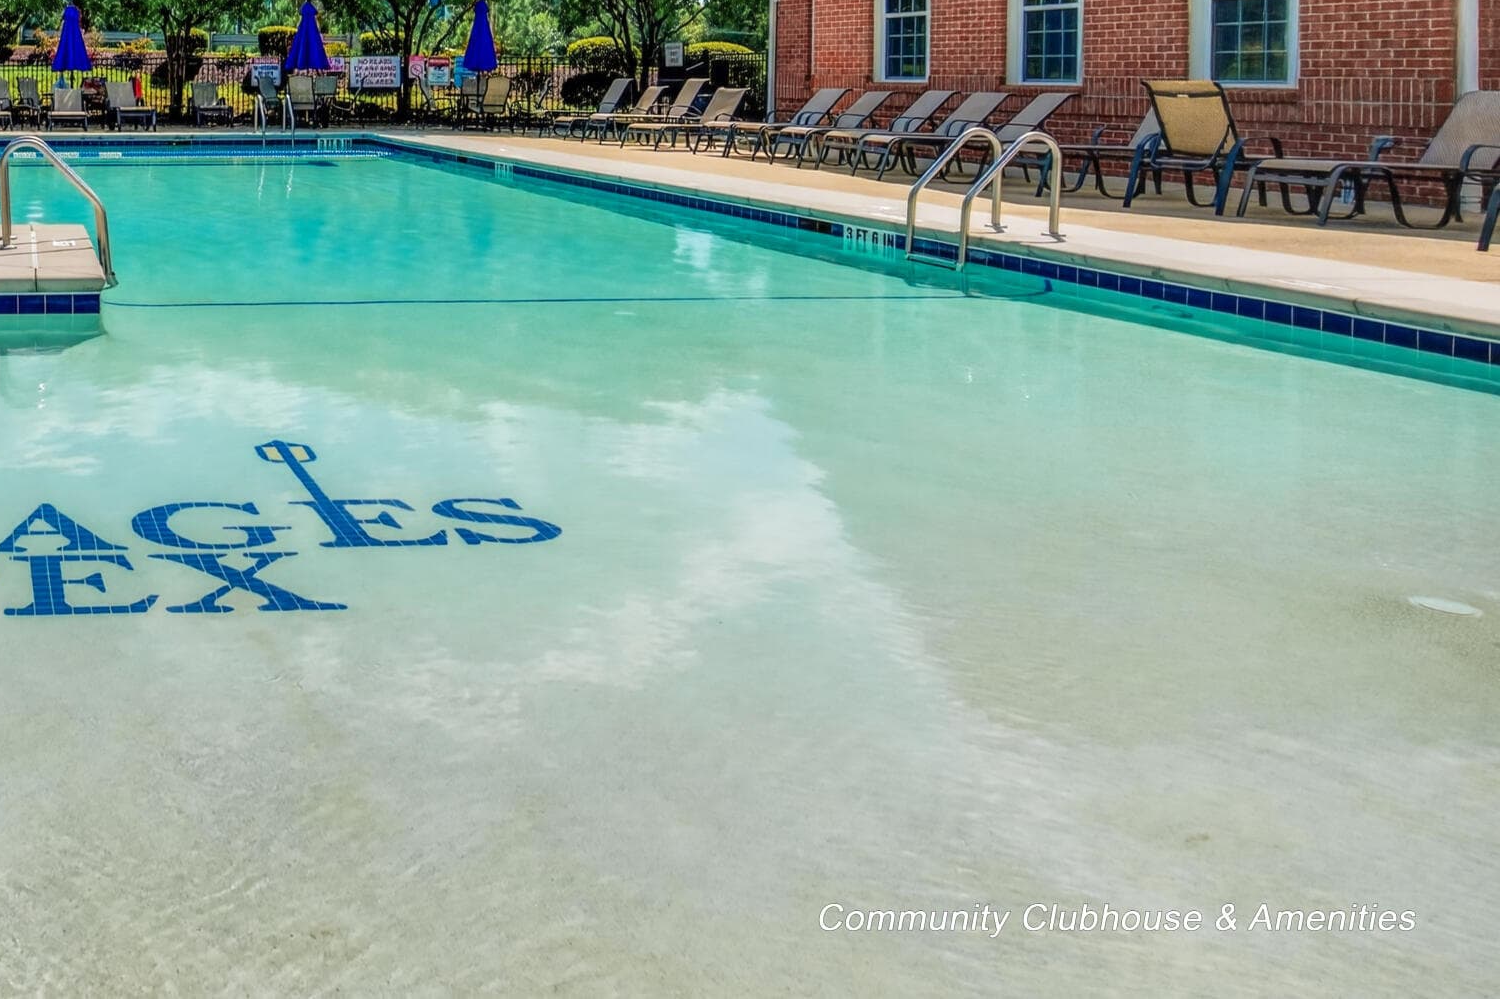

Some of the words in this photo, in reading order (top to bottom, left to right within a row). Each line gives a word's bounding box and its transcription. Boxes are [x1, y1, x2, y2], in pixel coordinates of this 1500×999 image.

[845, 227, 853, 239] 3
[856, 228, 869, 242] FT
[871, 231, 879, 245] 6
[883, 232, 895, 249] IN
